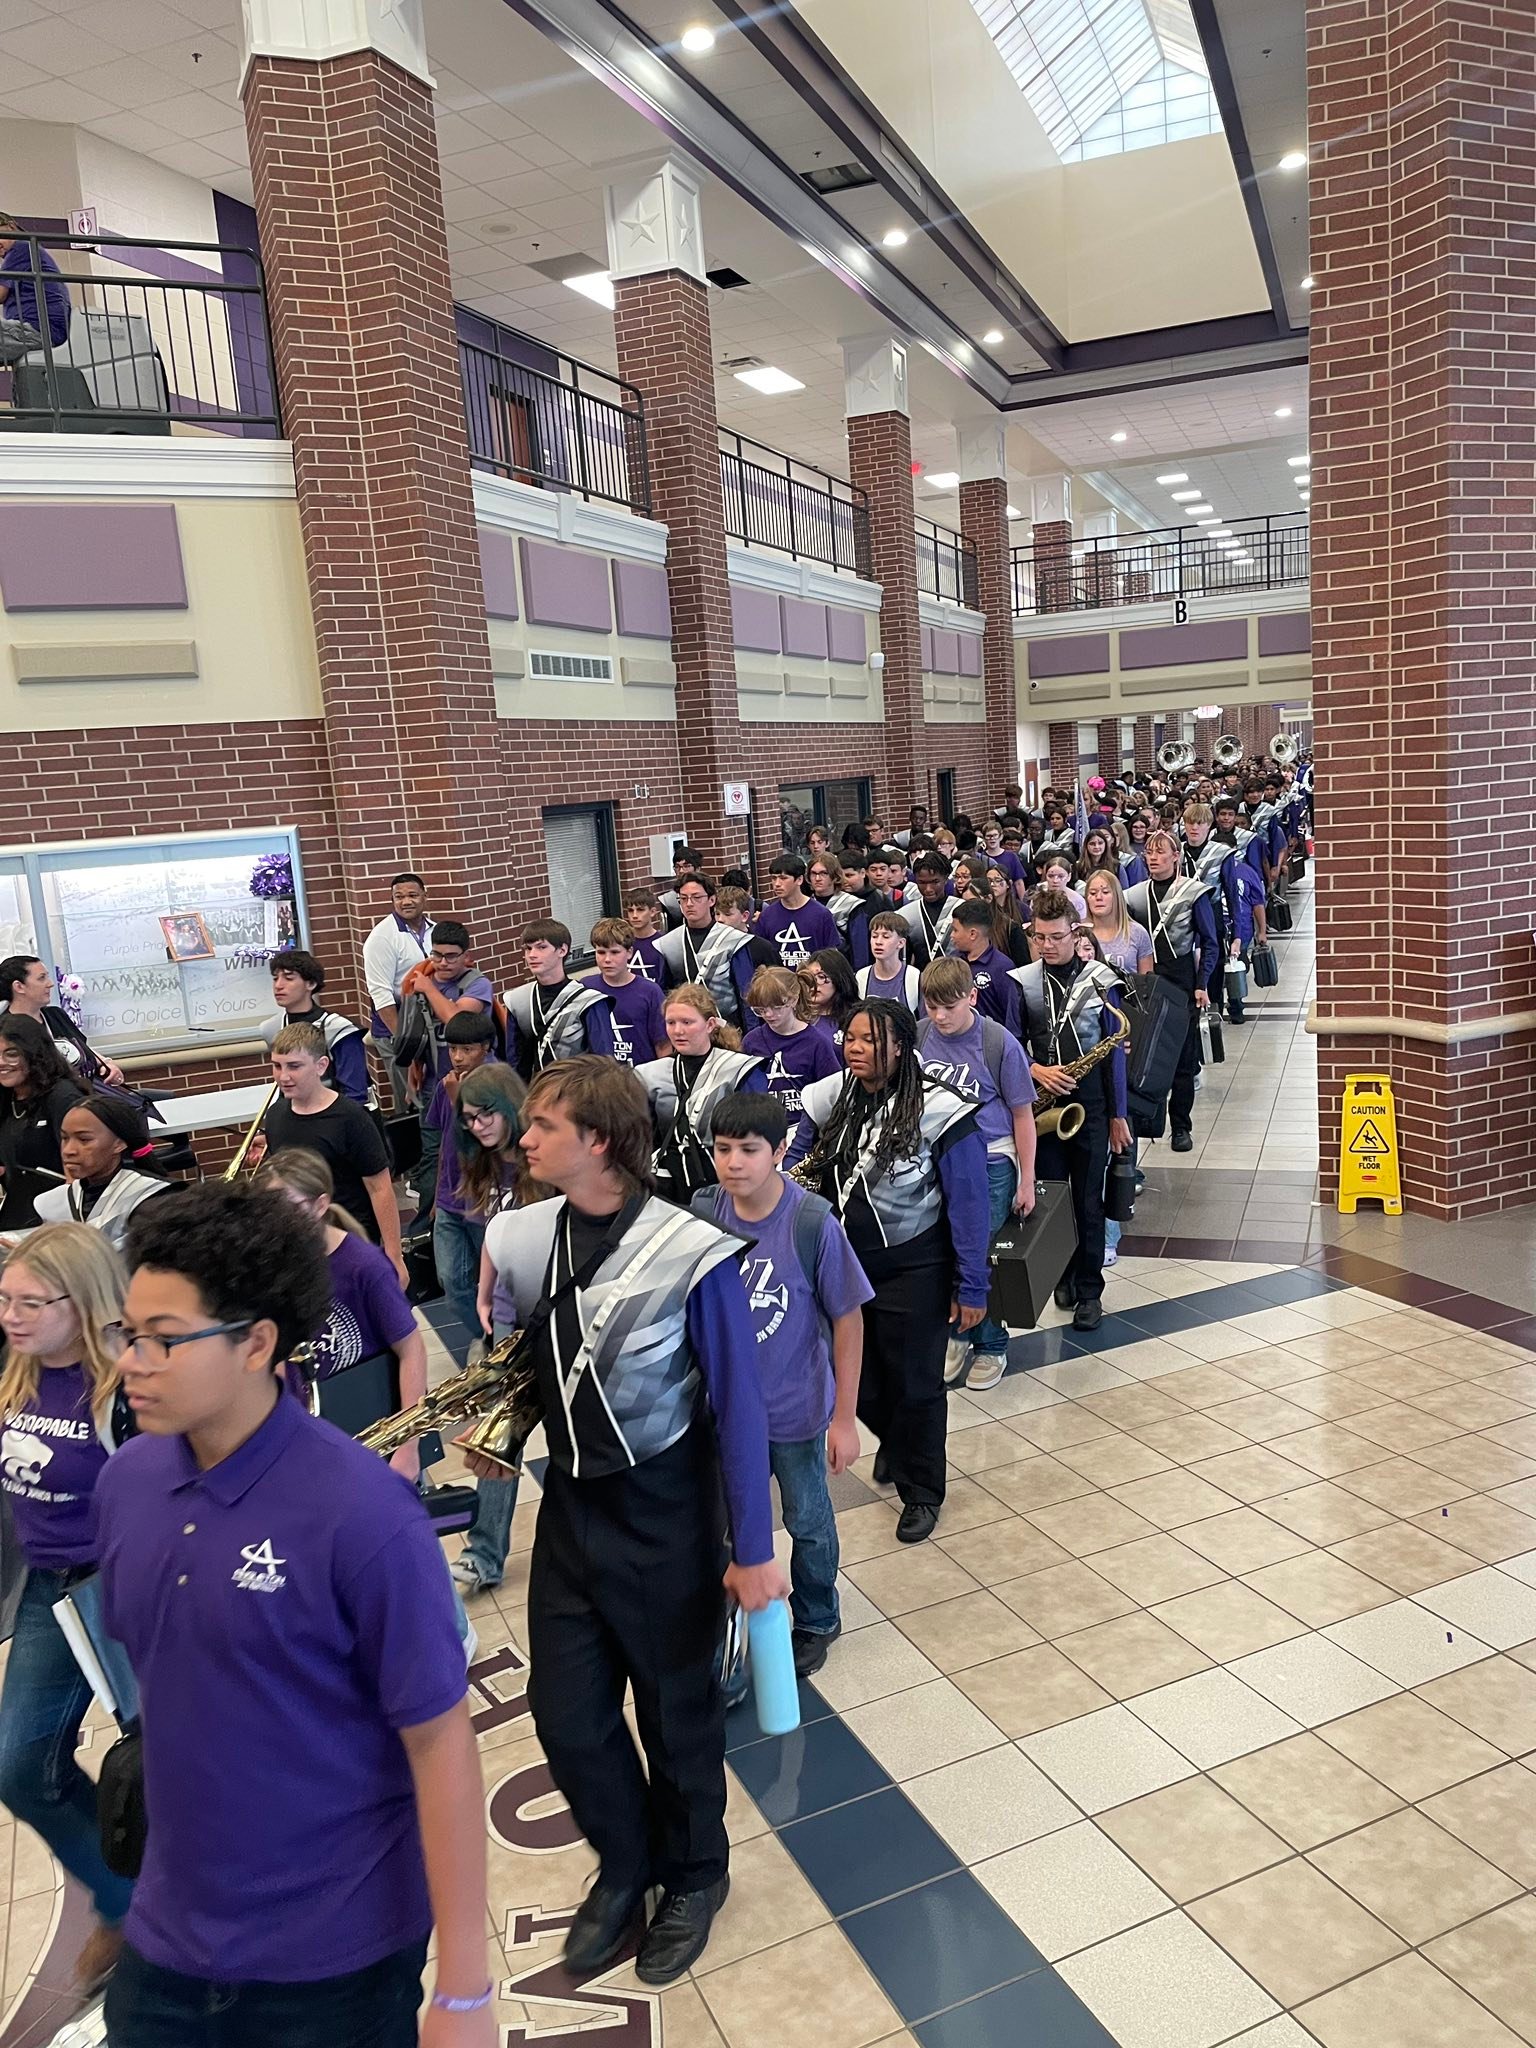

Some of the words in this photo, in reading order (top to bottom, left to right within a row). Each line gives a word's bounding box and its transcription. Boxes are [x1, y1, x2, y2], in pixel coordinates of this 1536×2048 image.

[1176, 600, 1187, 624] B
[84, 1012, 116, 1031] The
[121, 1006, 182, 1026] Choice
[194, 1003, 207, 1017] is
[213, 997, 257, 1014] Yours
[1351, 1106, 1386, 1115] CAUTION
